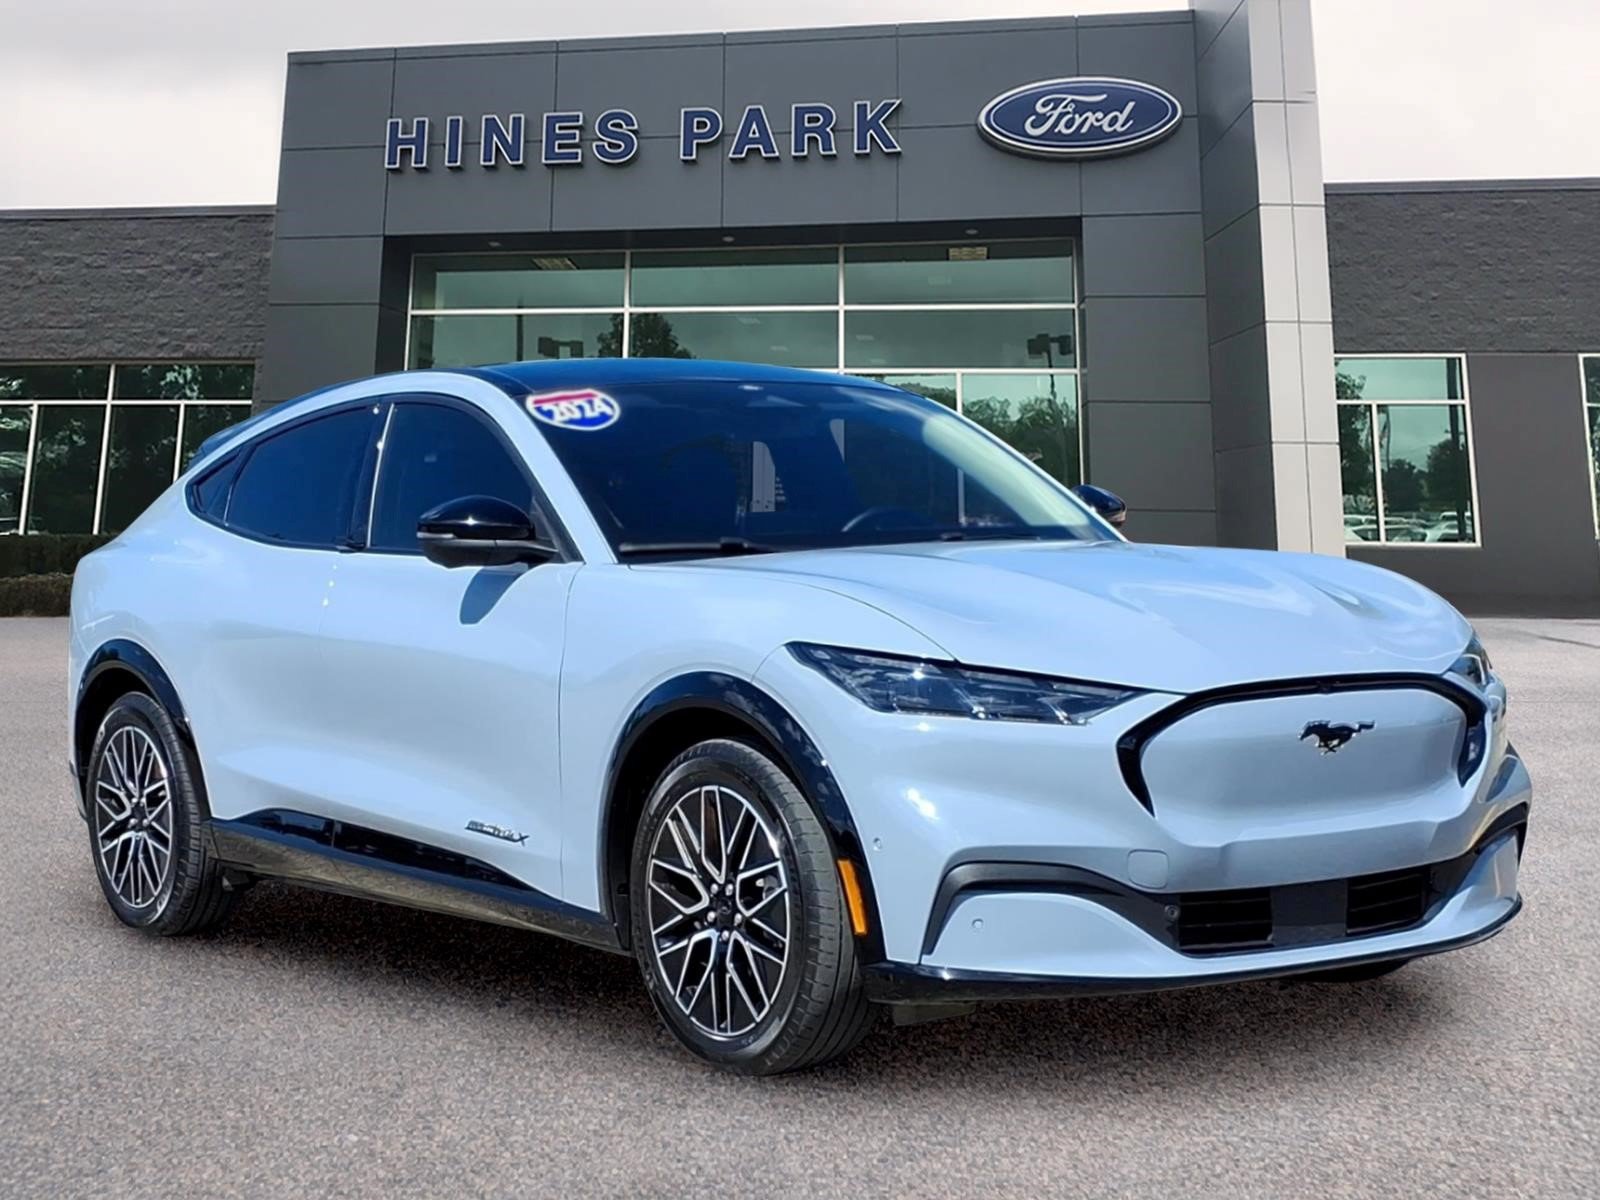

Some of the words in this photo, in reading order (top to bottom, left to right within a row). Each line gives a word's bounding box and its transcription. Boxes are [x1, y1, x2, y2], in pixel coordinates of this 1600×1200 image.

[384, 108, 640, 169] HINES
[679, 98, 903, 161] PARK
[1024, 93, 1136, 137] Ford
[533, 397, 614, 421] 2024
